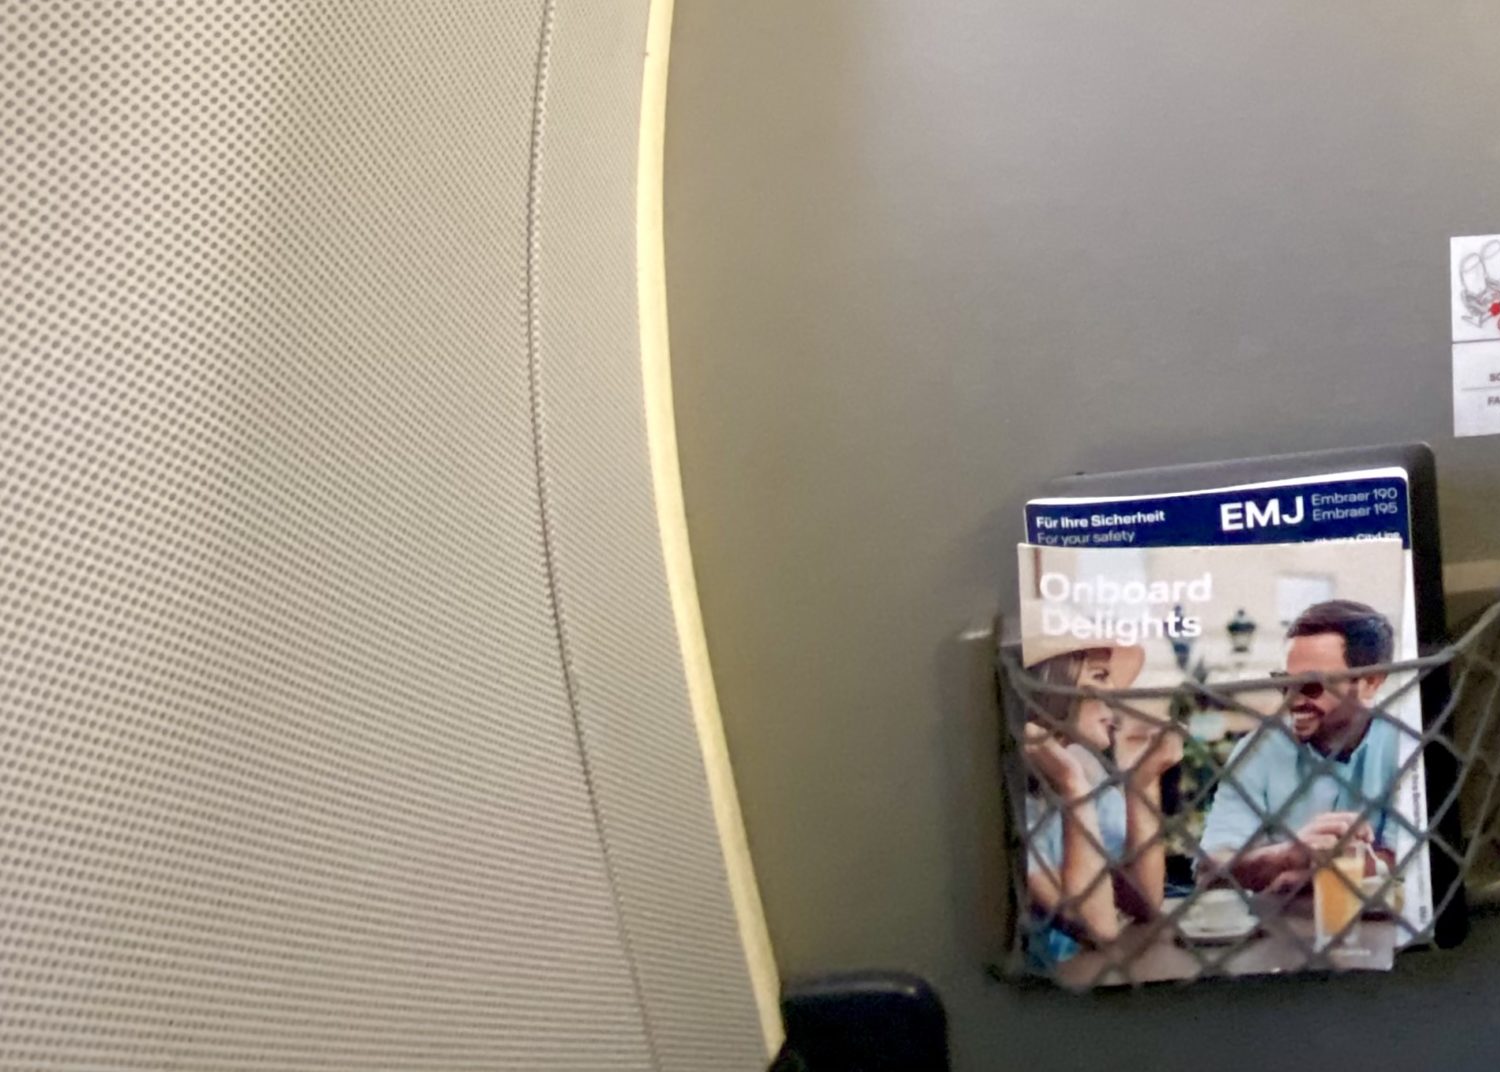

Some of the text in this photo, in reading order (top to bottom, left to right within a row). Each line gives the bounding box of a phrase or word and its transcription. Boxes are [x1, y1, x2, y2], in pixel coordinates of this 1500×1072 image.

[1311, 487, 1398, 506] Embraer 190
[1036, 510, 1165, 529] Für Ihre Sicherheit
[1220, 496, 1305, 532] EMJ
[1312, 502, 1398, 522] Embraer 195
[1037, 530, 1136, 546] For your safety
[1039, 573, 1212, 603] Onboard
[1041, 609, 1202, 647] Delights
